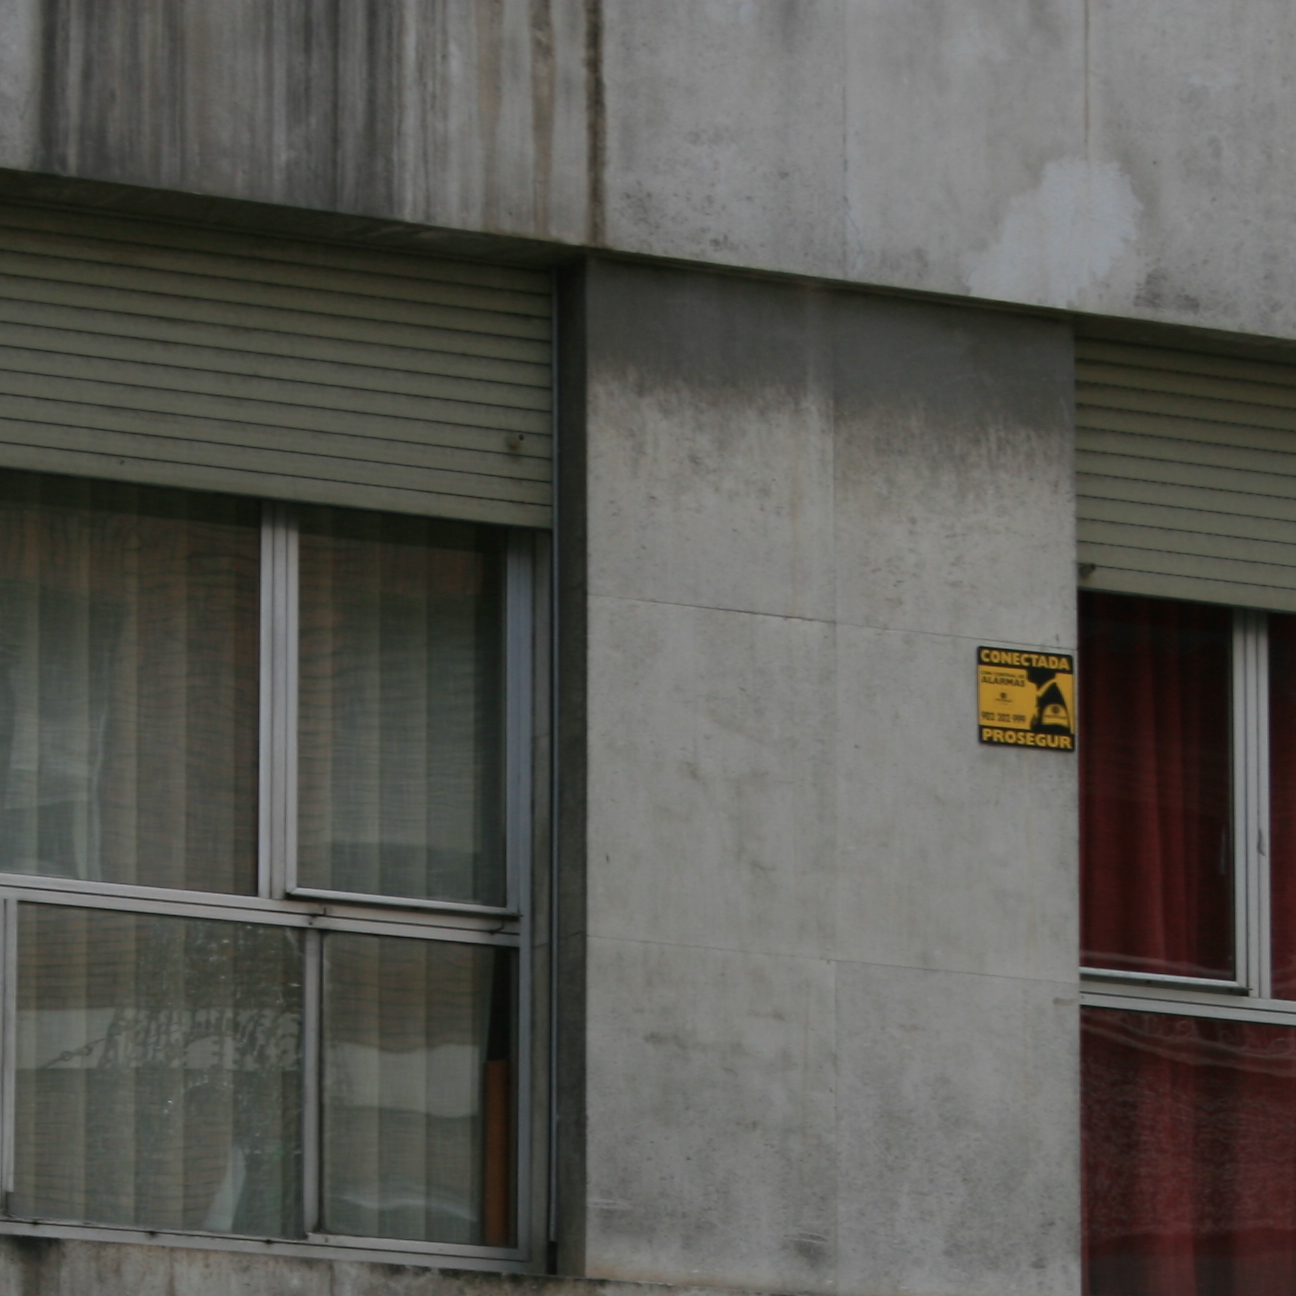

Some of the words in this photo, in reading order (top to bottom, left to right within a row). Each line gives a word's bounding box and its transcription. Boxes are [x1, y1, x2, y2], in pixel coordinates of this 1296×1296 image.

[980, 649, 1070, 670] CONECTADA
[981, 676, 1026, 687] ALARMAS
[982, 728, 1072, 749] PROSEGUR
